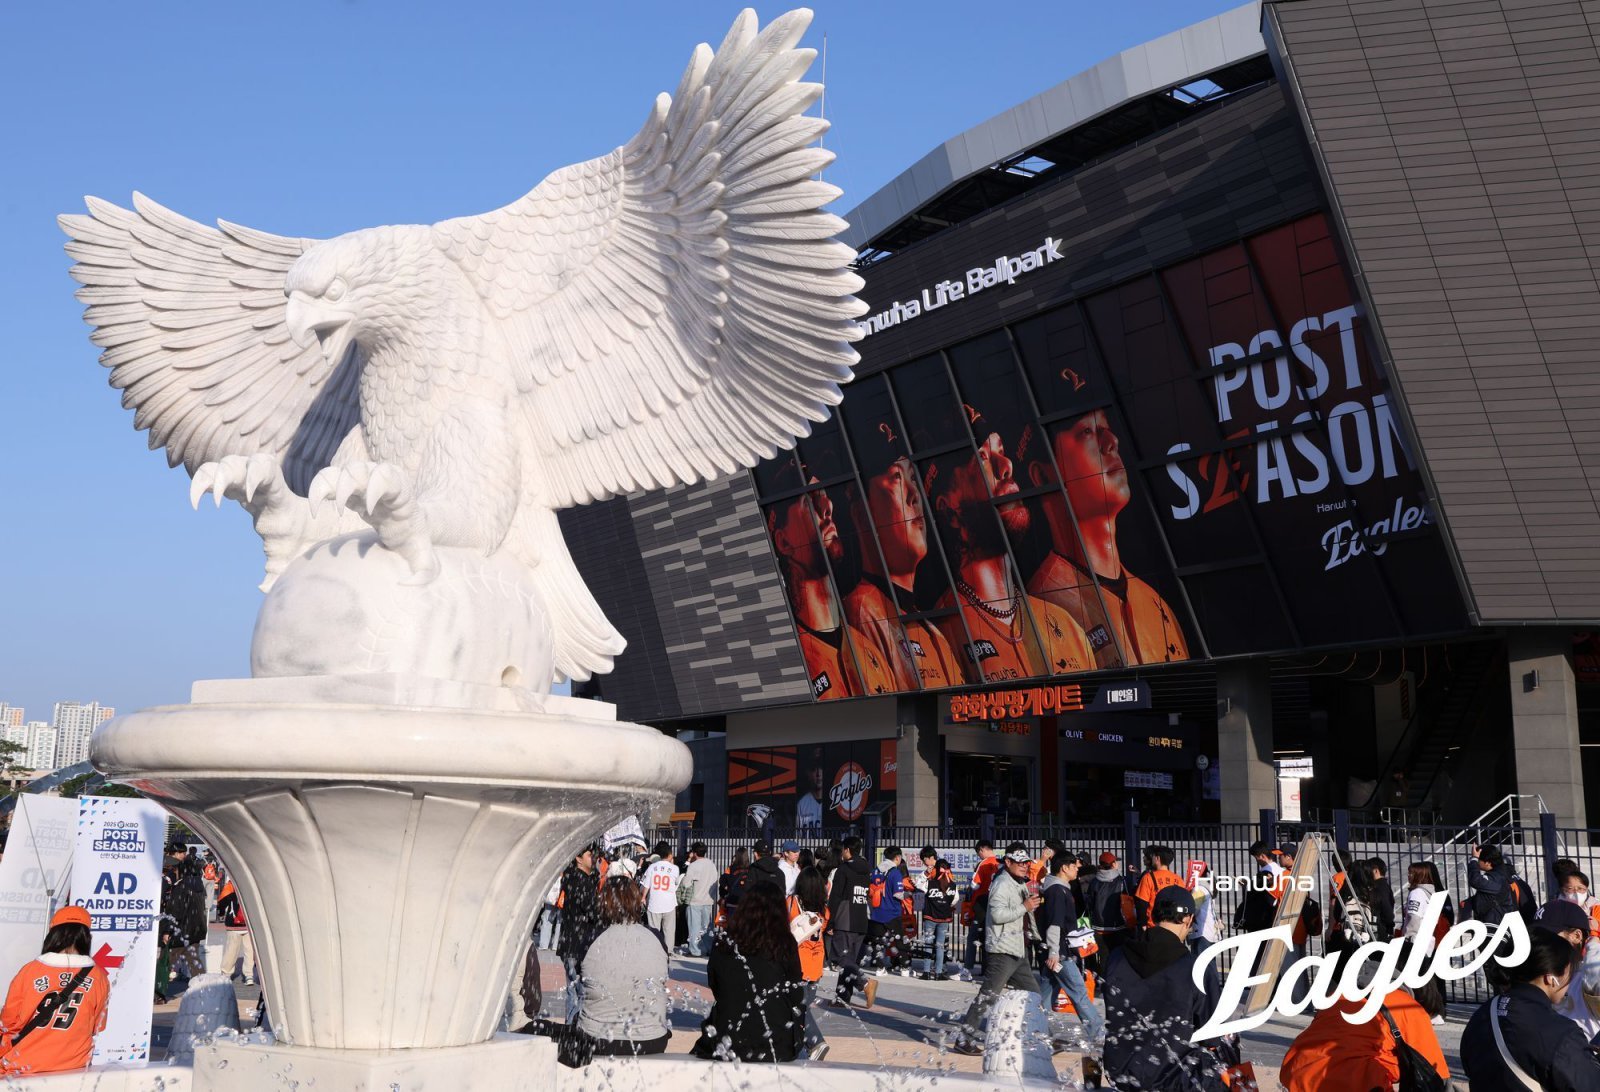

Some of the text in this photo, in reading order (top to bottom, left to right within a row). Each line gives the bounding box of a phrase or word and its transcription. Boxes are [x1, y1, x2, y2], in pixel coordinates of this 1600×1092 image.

[856, 236, 1065, 336] anwha Life Ballpark
[1208, 305, 1364, 423] POST
[985, 667, 1018, 682] anwha
[951, 684, 1084, 722] 한화생명게이트
[1065, 729, 1124, 743] OLIVE CHICKEN
[829, 774, 873, 810] Eagles
[103, 830, 137, 840] POST
[94, 840, 144, 851] SEASON
[93, 872, 138, 895] AD
[653, 875, 670, 891] 99
[75, 899, 114, 909] CARD
[117, 899, 154, 909] DESK
[90, 916, 112, 929] 입증
